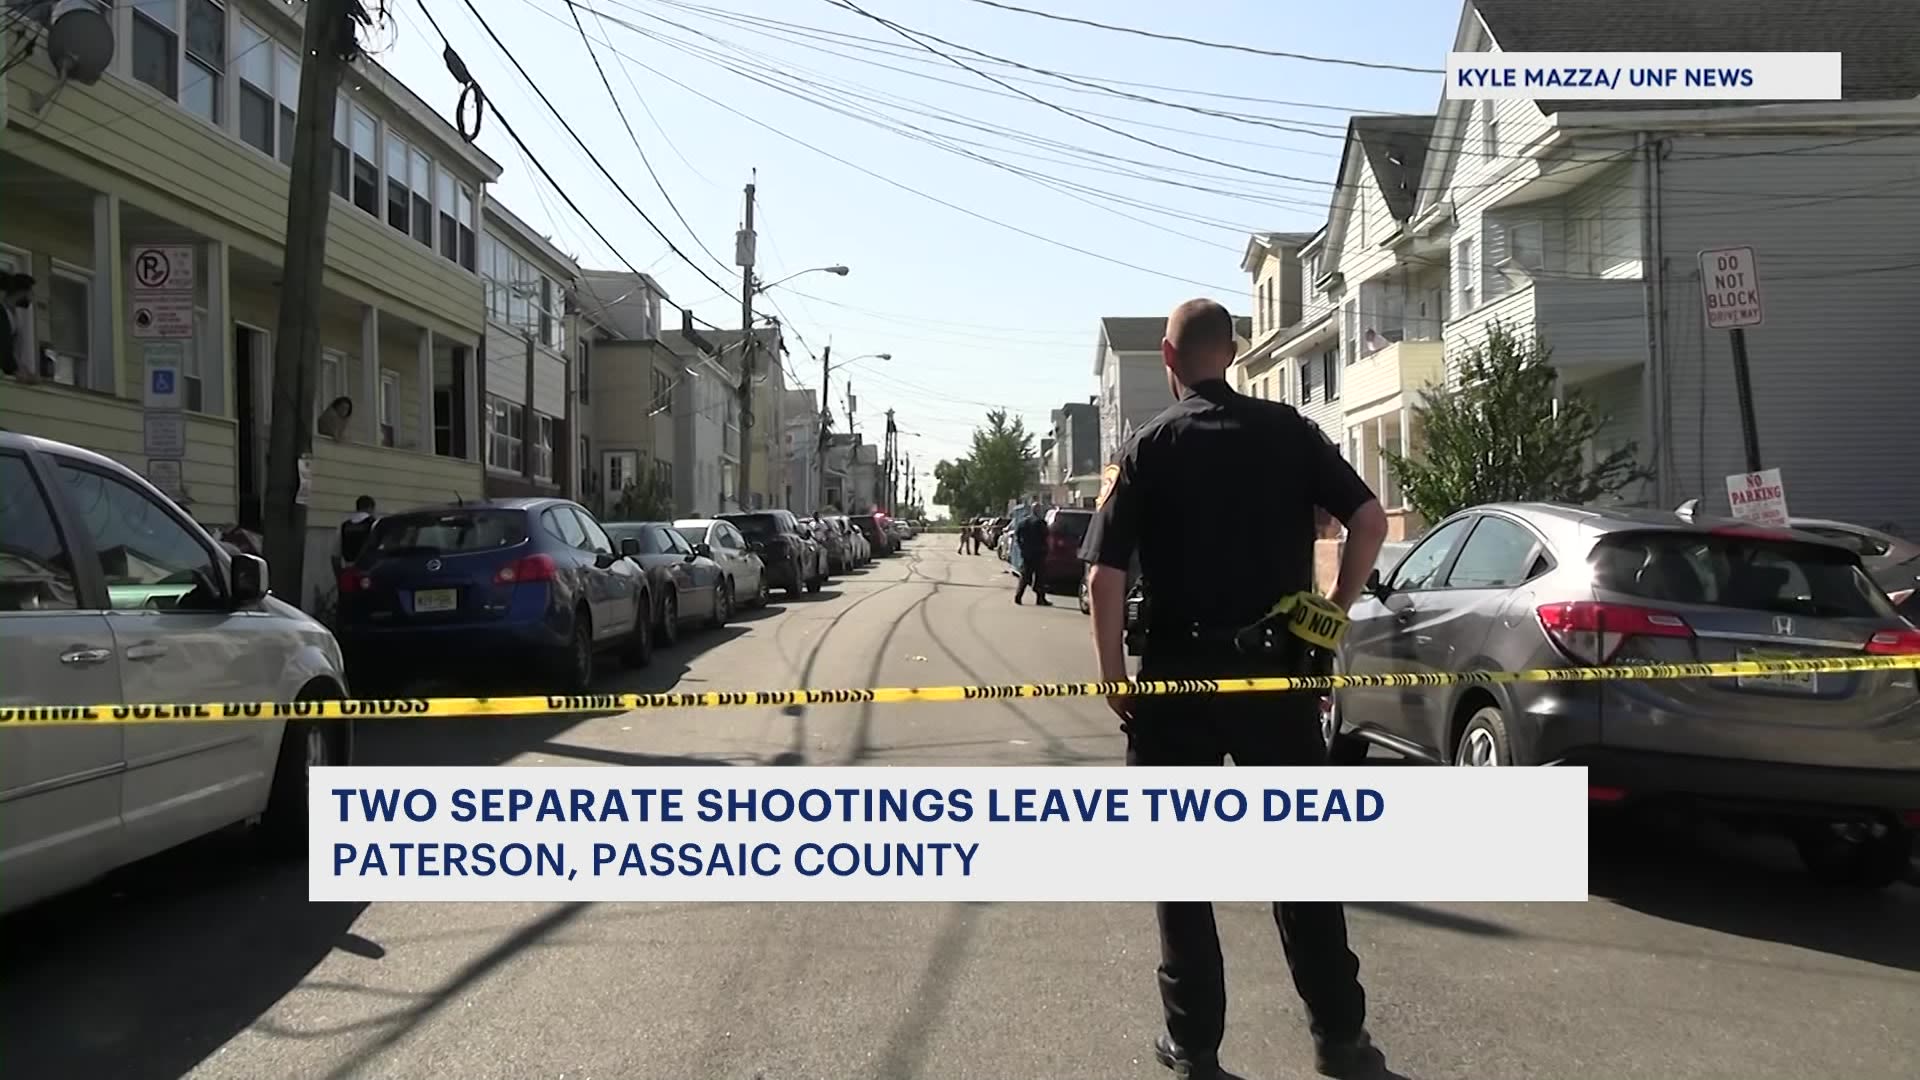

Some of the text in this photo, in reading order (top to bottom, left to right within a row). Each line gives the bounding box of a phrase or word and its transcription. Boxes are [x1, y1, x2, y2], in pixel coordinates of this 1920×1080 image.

[1718, 255, 1738, 271] DO
[1715, 272, 1744, 289] NOT
[1708, 289, 1757, 309] BLOCK
[1746, 474, 1762, 488] NO
[1731, 486, 1781, 505] PARKING
[1308, 611, 1343, 639] NOT
